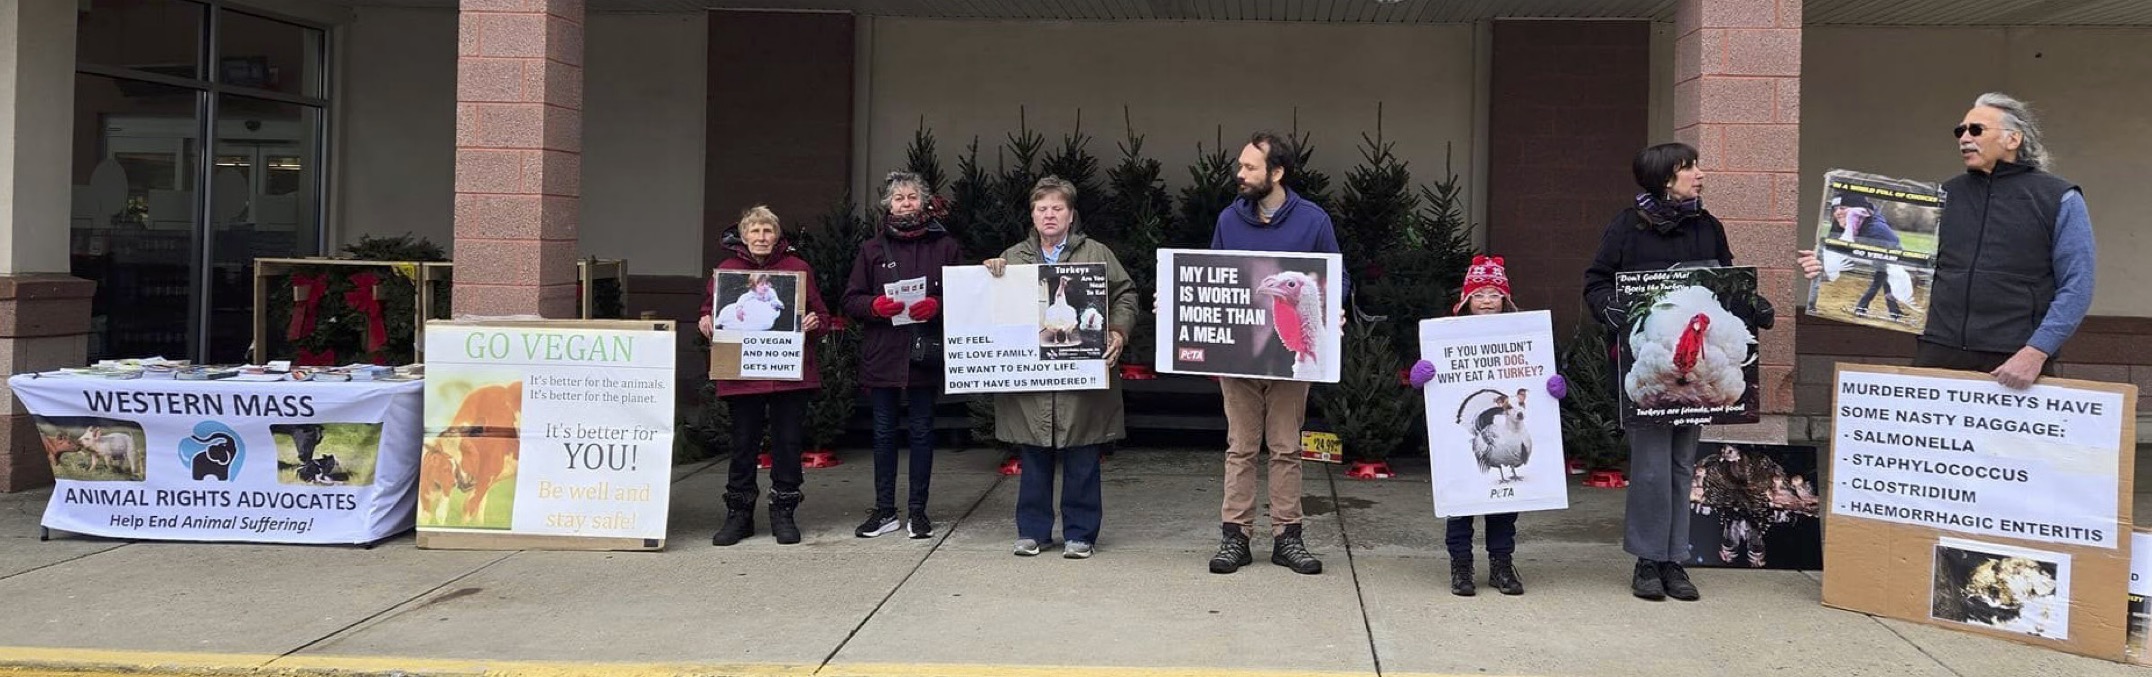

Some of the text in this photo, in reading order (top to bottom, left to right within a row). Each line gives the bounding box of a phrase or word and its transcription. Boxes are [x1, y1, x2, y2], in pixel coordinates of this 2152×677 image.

[1179, 266, 1238, 284] MY LIFE
[1179, 286, 1250, 304] IS WORTH
[1179, 306, 1265, 325] MORE THAN
[948, 336, 994, 345] WE FEEL.
[1179, 325, 1235, 344] A MEAL
[466, 332, 634, 362] GO VEGAN
[948, 351, 963, 359] WE
[967, 350, 993, 359] LOVE
[1444, 341, 1532, 358] IF YOU WOULDN'T
[949, 363, 1079, 374] WE WANT TO ENJOY LIFE.
[1451, 359, 1469, 370] EAT
[1473, 357, 1501, 368] YOUR
[530, 375, 666, 389] It's better for the animals.
[949, 380, 981, 388] DON'T
[983, 379, 1010, 388] HAVE
[1014, 379, 1027, 387] US
[1030, 378, 1087, 386] MURDERED
[1438, 366, 1544, 384] WHY EAT A TURKEY?
[84, 390, 315, 417] WESTERN MASS
[530, 390, 656, 404] It's better for the planet.
[1842, 382, 2103, 415] MURDERED TURKEYS HAVE
[1637, 408, 1665, 416] Turkeys
[1725, 403, 1744, 413] food
[1841, 406, 2065, 437] SOME NASTY BAGGAGE:
[546, 423, 658, 441] It's better for
[1853, 430, 1975, 452] SALMONELLA
[564, 443, 638, 471] YOU!
[1852, 454, 2029, 482] STAPHYLOCOCCUS
[65, 487, 356, 510] ANIMAL RIGHTS ADVOCATES
[538, 481, 650, 502] Be well and
[1852, 478, 1976, 503] CLOSTRIDIUM
[110, 514, 313, 533] Help End Animal Suffering!
[546, 512, 635, 532] stay safe!
[1851, 501, 1993, 530] HAEMORRHAGIC
[2000, 520, 2103, 542] ENTERITIS
